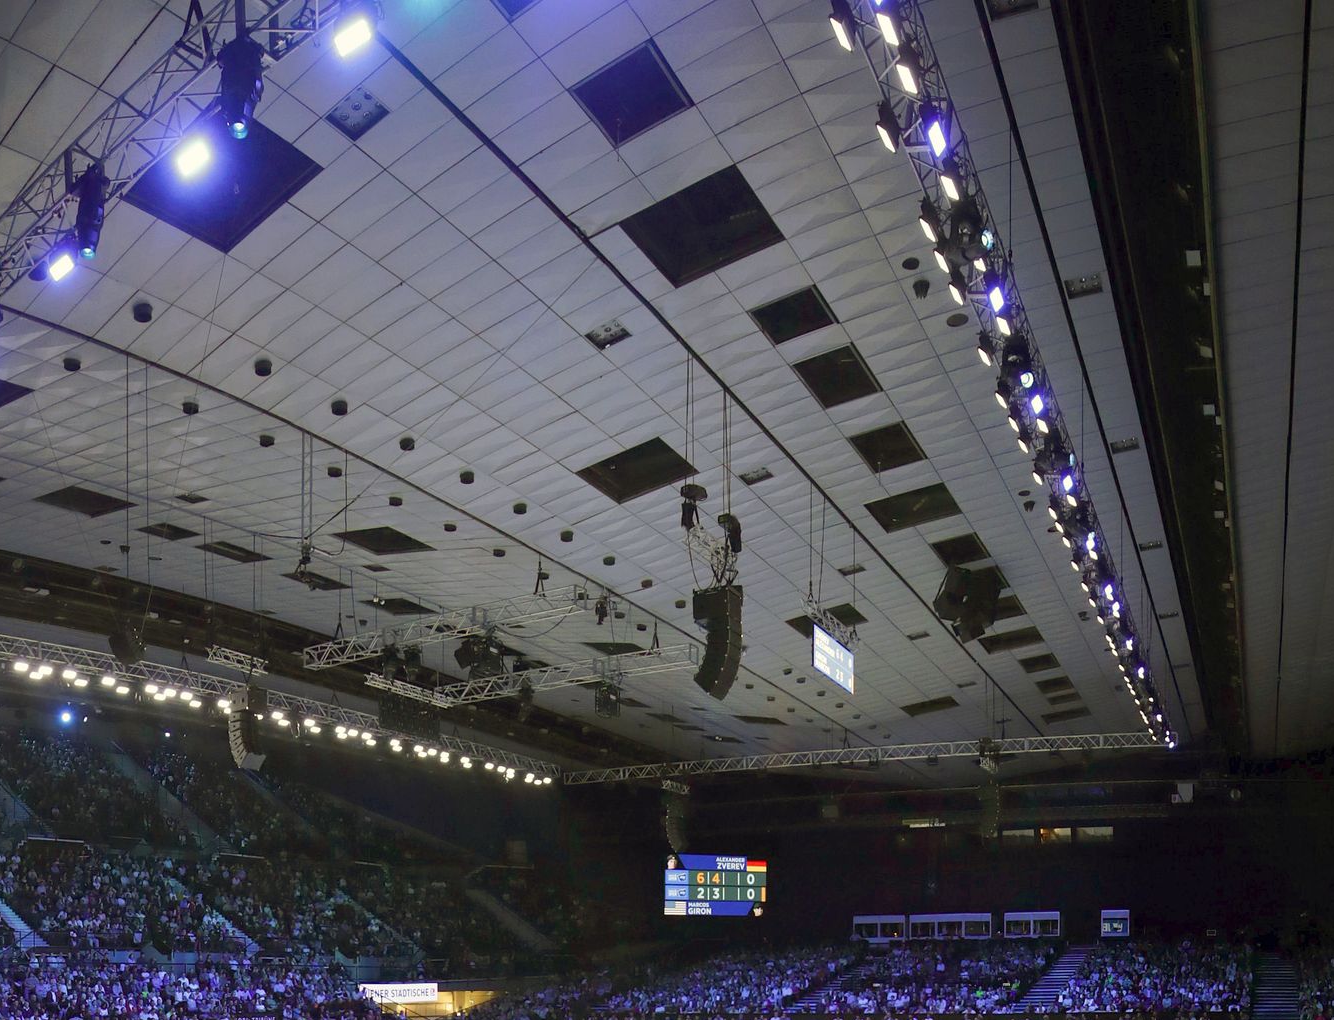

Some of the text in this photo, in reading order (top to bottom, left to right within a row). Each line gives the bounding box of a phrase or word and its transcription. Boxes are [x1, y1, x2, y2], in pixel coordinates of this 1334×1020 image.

[696, 873, 755, 884] 6 4 0
[697, 888, 755, 899] 2 3 0
